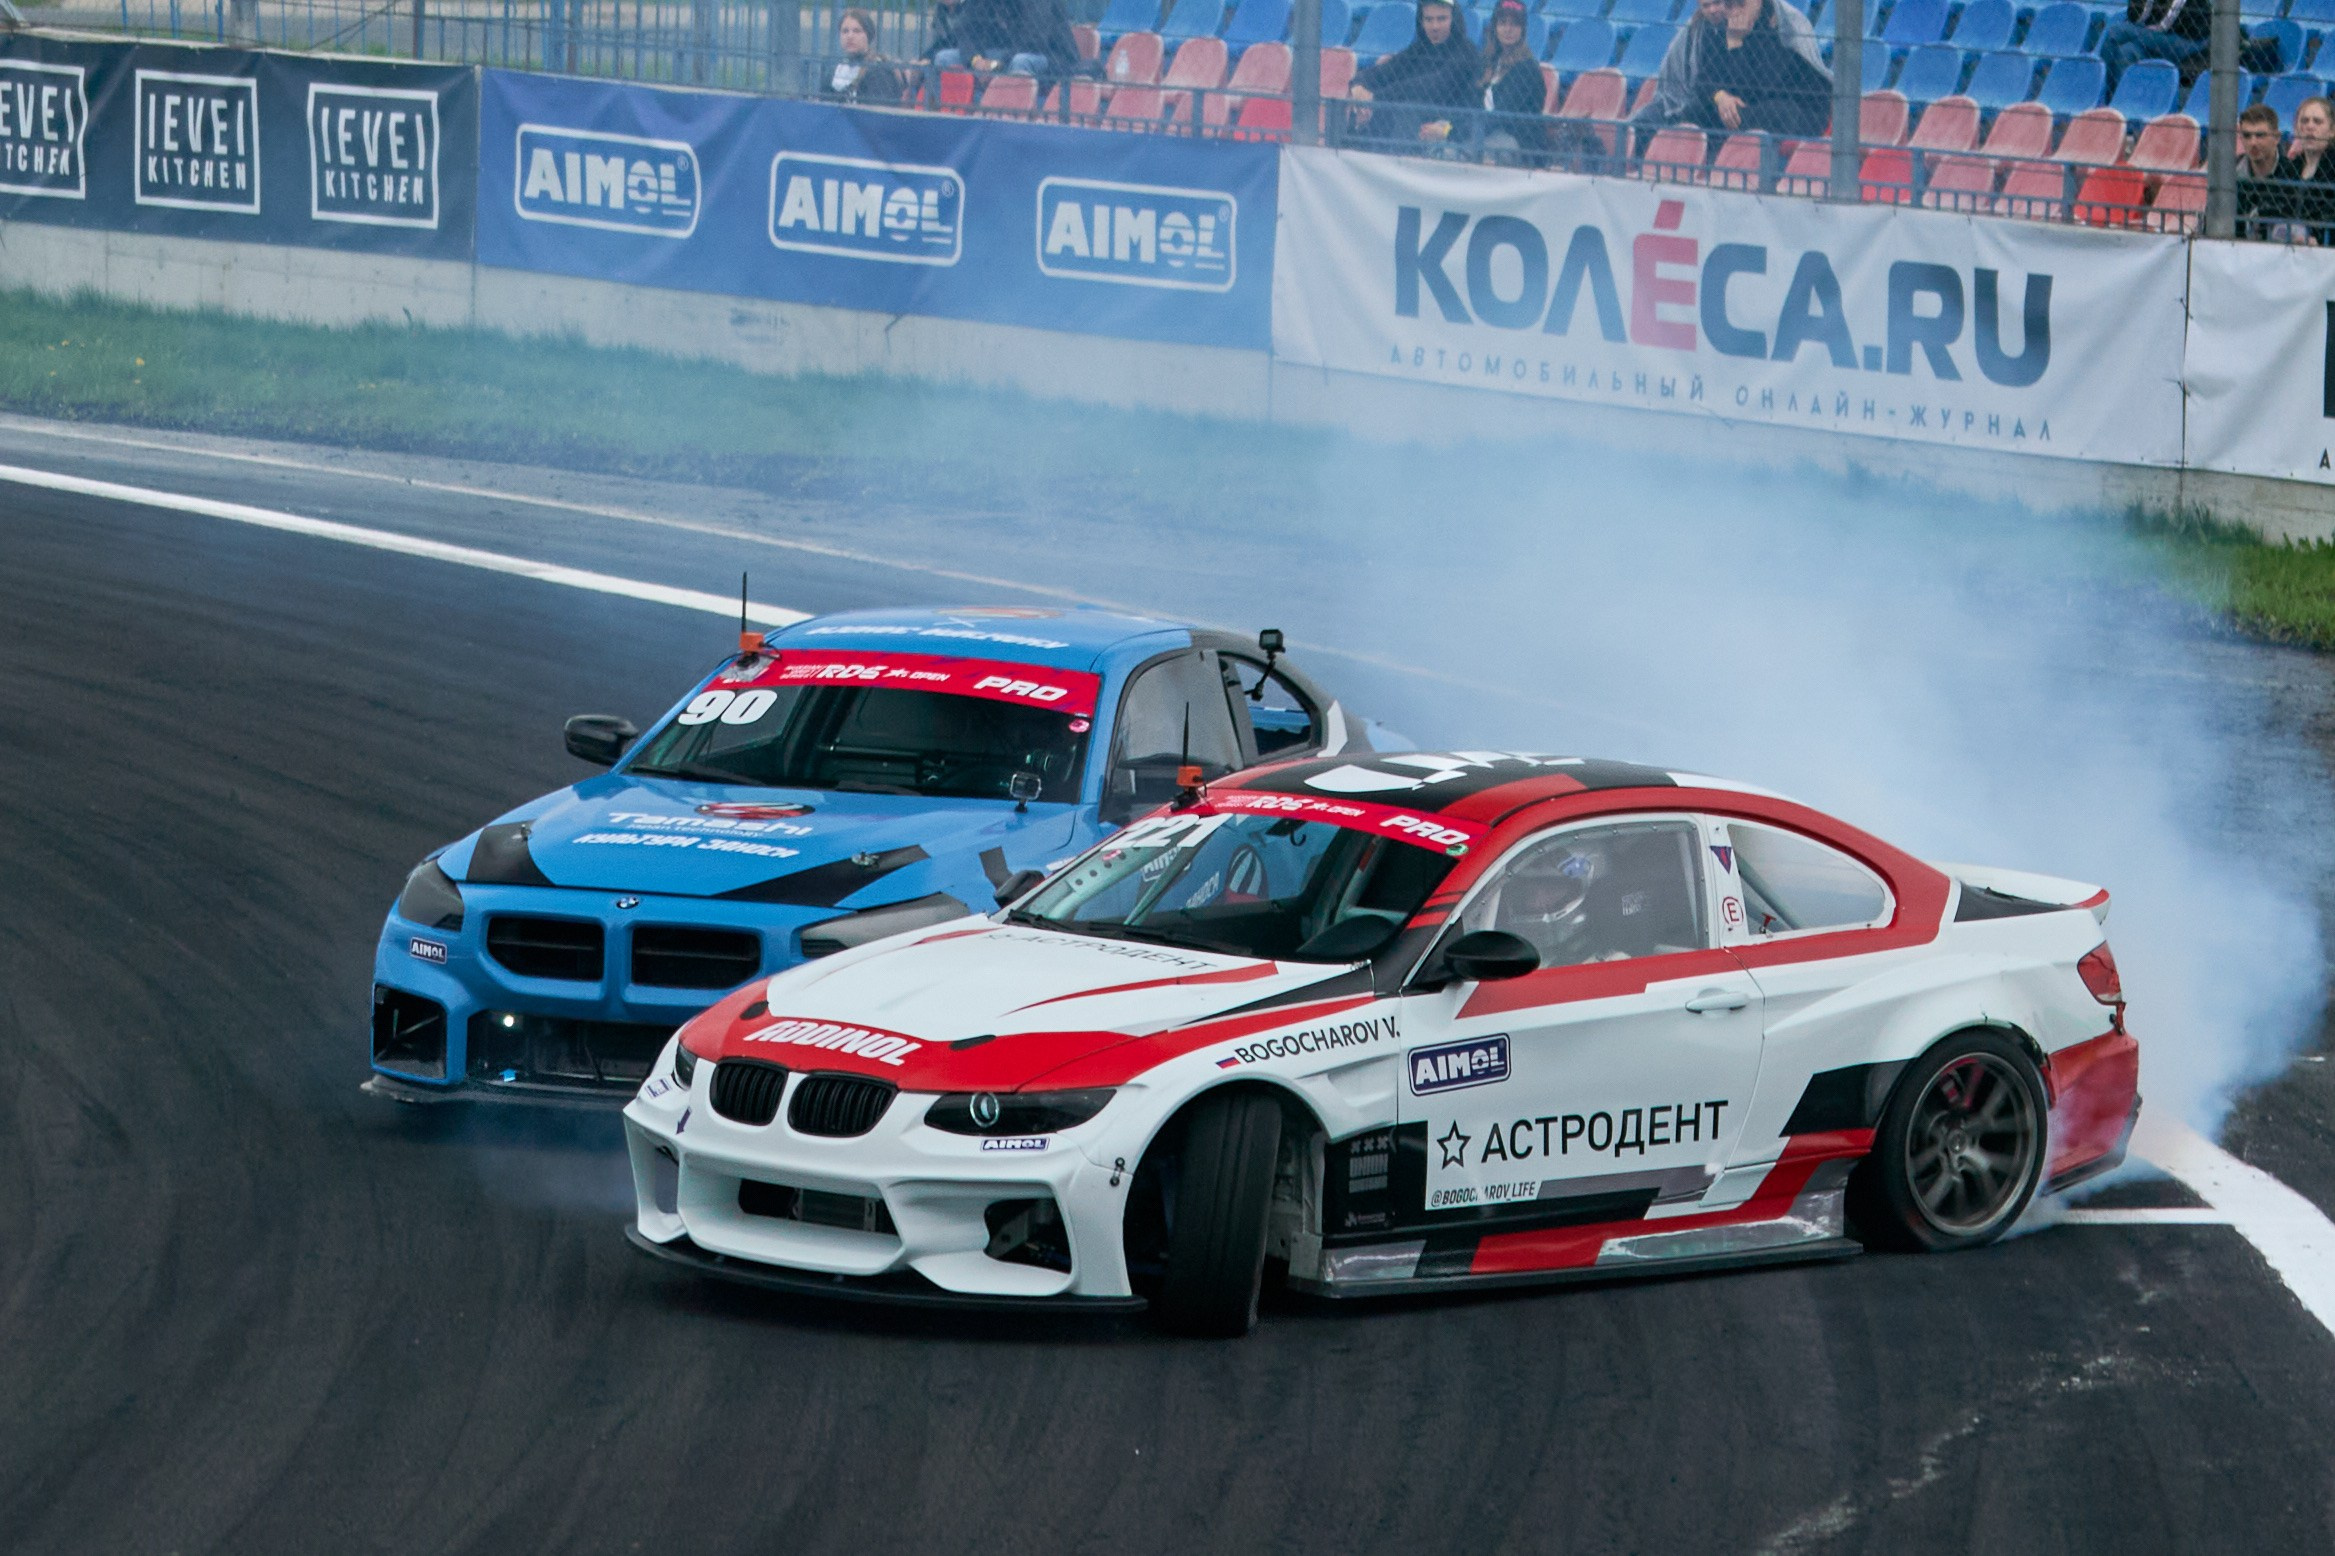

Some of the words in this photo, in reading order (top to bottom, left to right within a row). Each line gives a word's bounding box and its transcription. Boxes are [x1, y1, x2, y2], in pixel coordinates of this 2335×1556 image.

[148, 156, 247, 190] KITCHEN
[325, 170, 424, 205] KITCHEN
[524, 148, 691, 217] AIMOL
[778, 175, 953, 245] AIMOL
[1046, 201, 1225, 271] AIMOL
[1391, 346, 1704, 401] АВТОМОБИЛЬНЫЙ
[1735, 384, 2053, 442] ОНЛАЙН-ЖУРНАЛ
[816, 664, 889, 680] RDS
[973, 675, 1068, 702] PRO
[678, 689, 778, 726] 90
[608, 811, 814, 836] Tamashi
[1101, 813, 1234, 852] 221
[1379, 814, 1471, 846] PRO
[1726, 902, 1741, 923] E
[412, 941, 445, 959] AIMOL
[743, 1020, 922, 1067] ADDINOL
[1235, 1019, 1380, 1064] BOGOCHAROV
[1382, 1016, 1400, 1038] V.
[1415, 1046, 1505, 1086] AIMOL
[984, 1139, 1045, 1150] AIMOL
[1481, 1100, 1729, 1164] АСТРОДЕНТ
